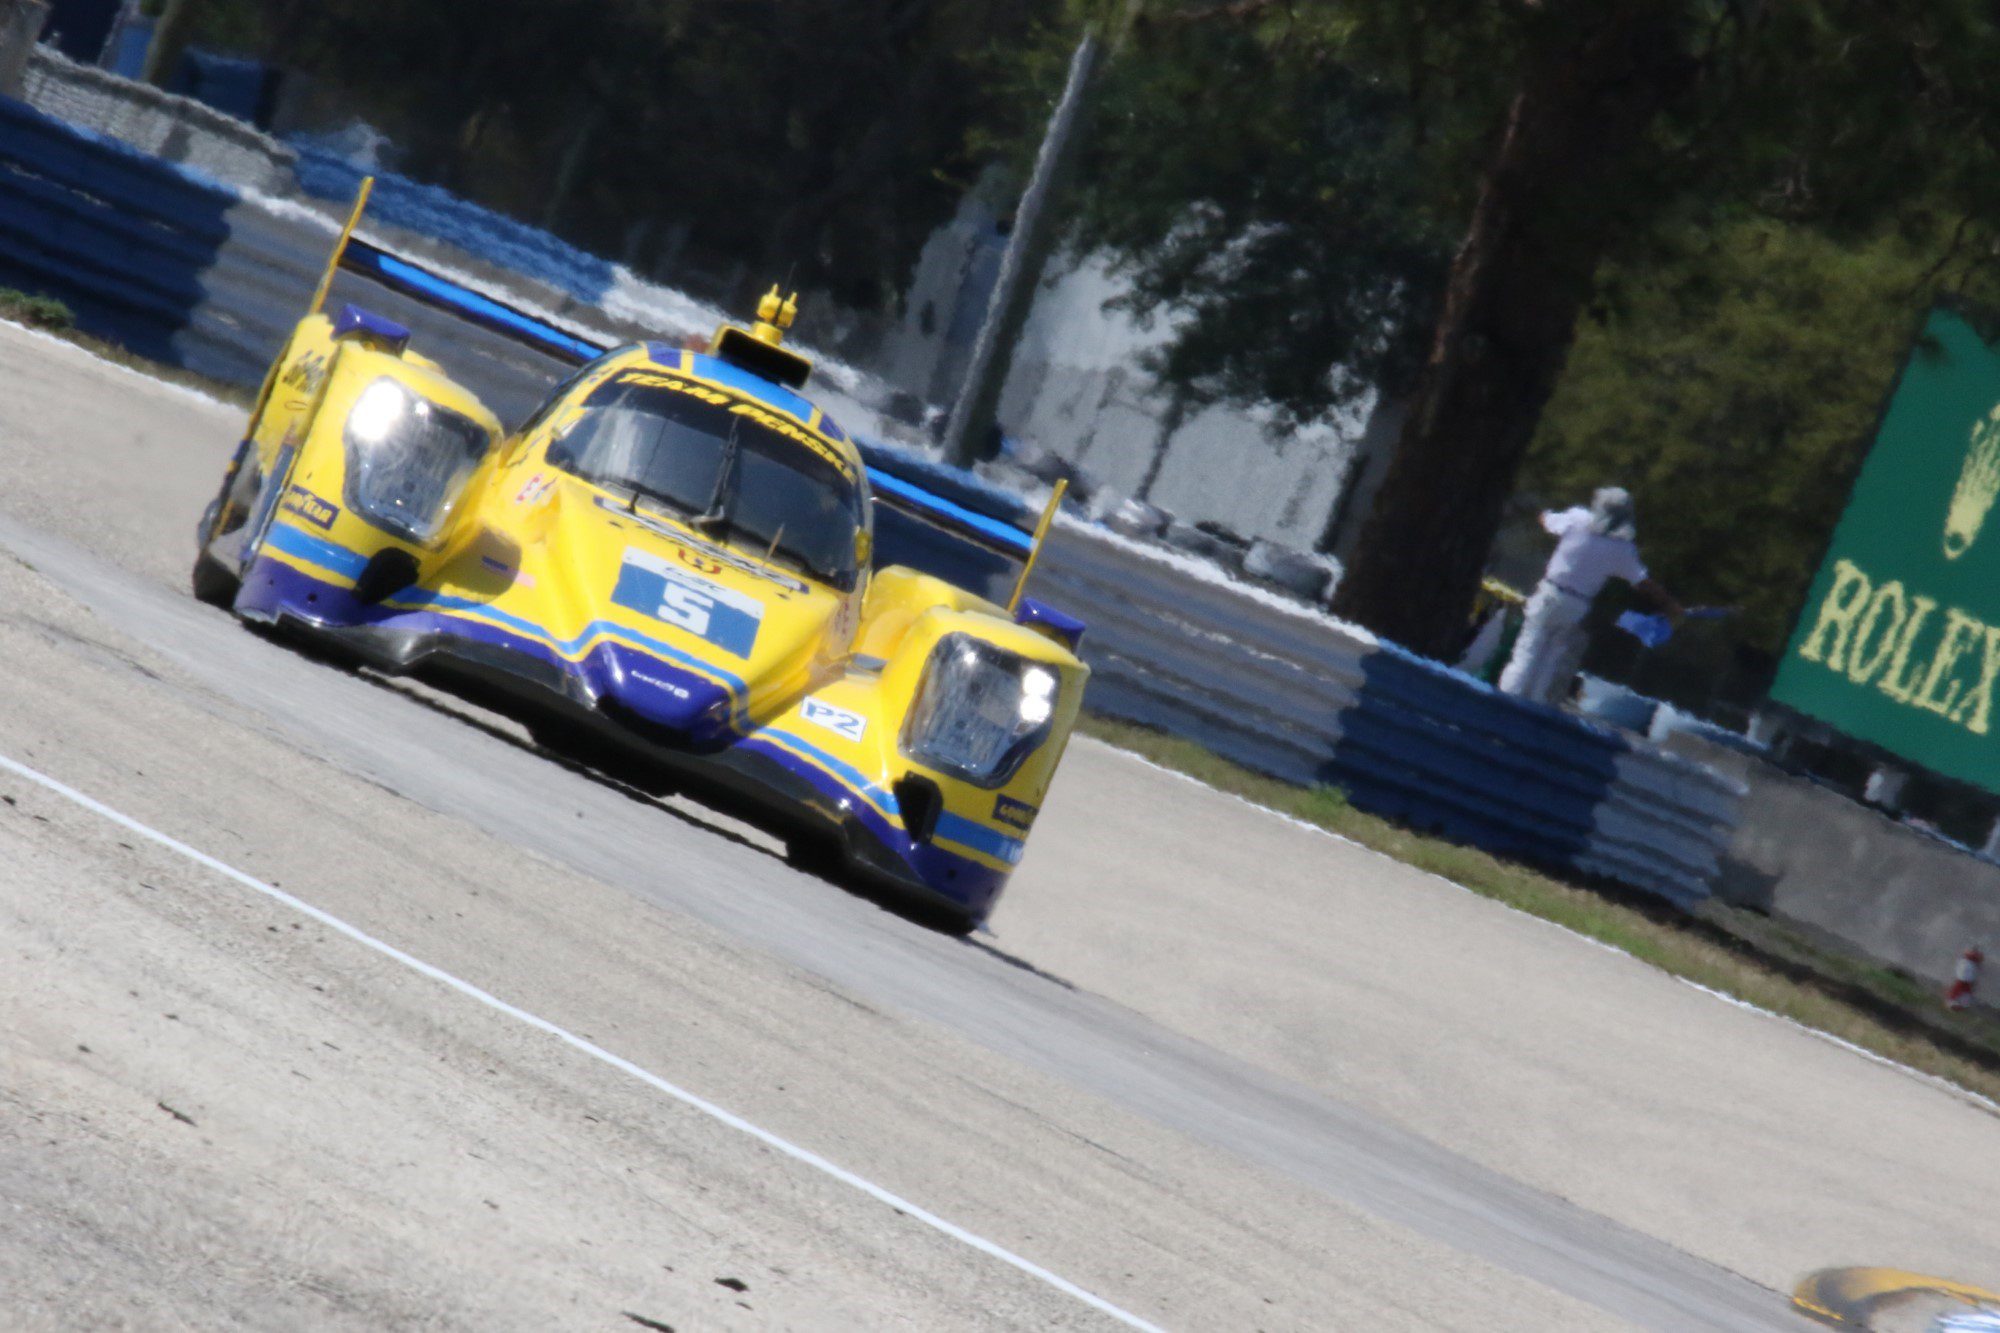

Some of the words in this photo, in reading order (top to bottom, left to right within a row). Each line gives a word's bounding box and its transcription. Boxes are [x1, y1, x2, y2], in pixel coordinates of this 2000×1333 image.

[616, 373, 730, 405] TEAM
[657, 580, 714, 636] 5
[1799, 558, 2000, 735] ROLEX
[805, 700, 861, 736] P2
